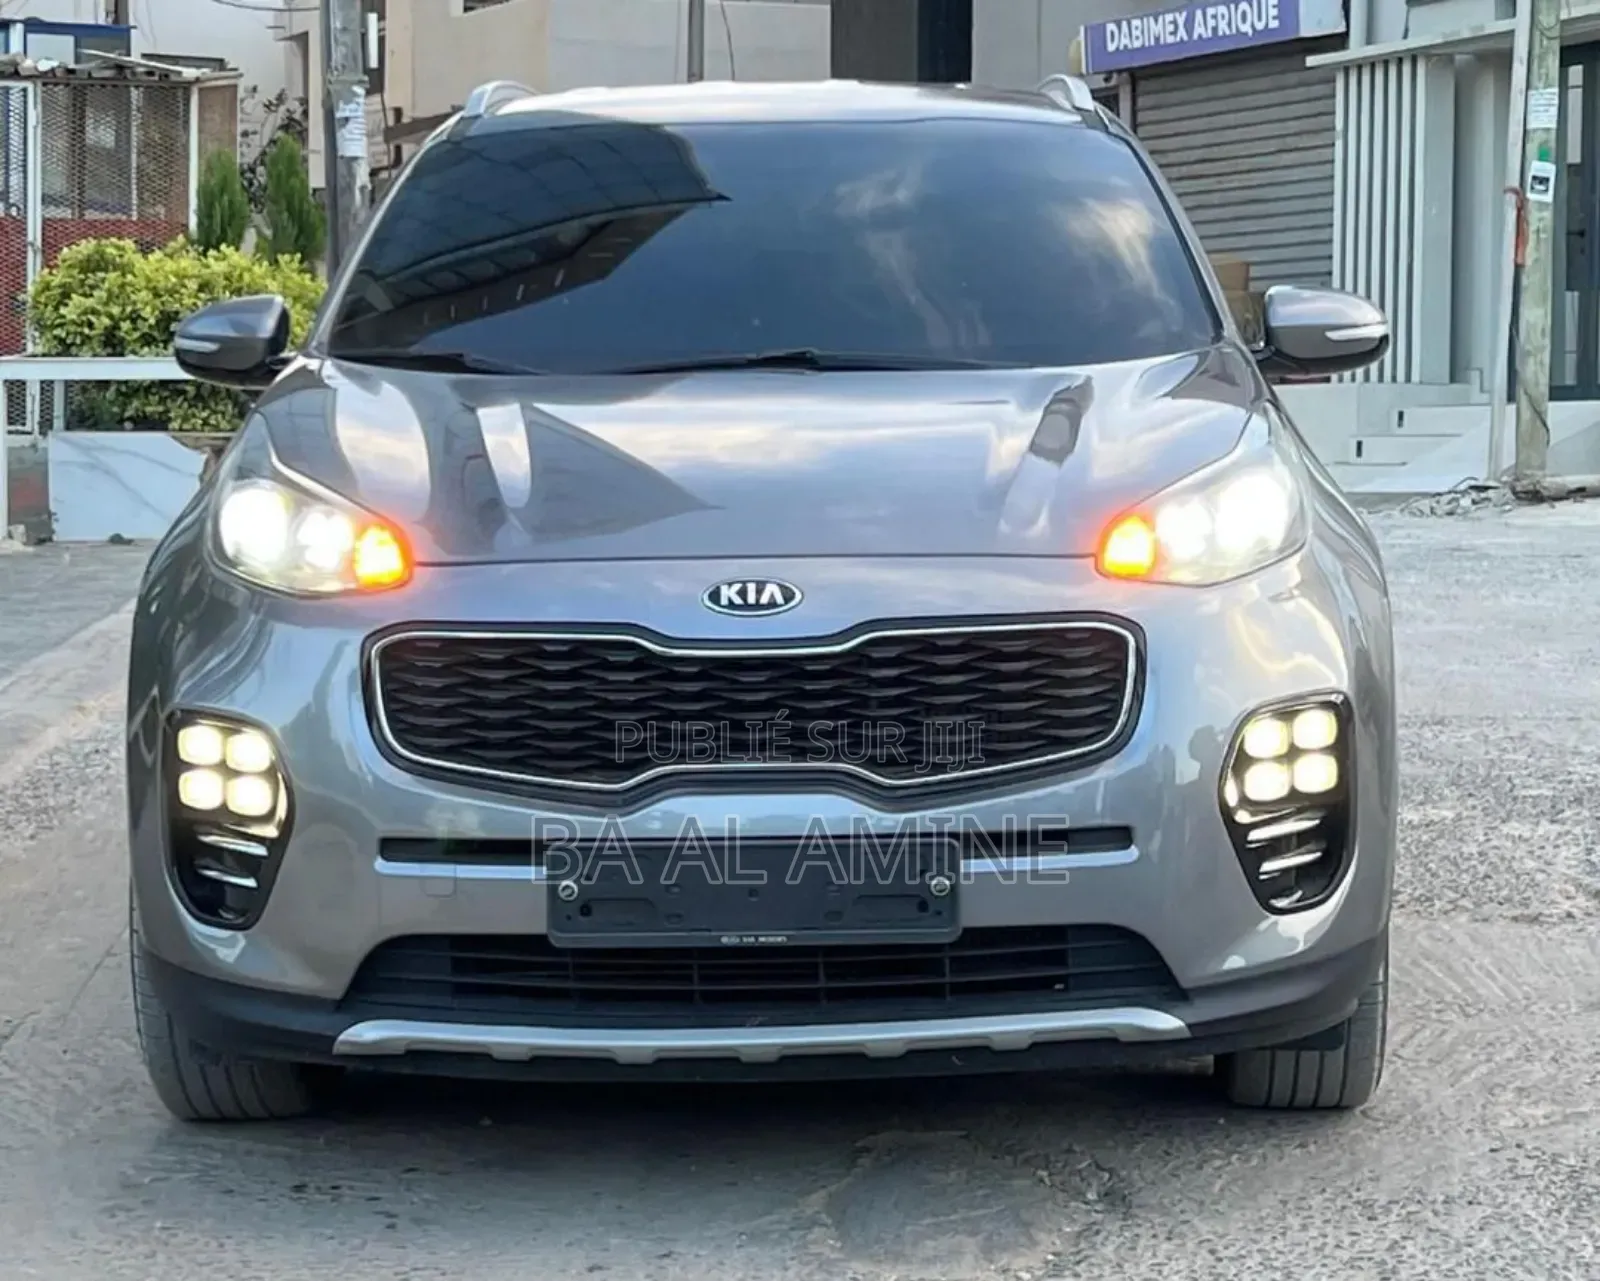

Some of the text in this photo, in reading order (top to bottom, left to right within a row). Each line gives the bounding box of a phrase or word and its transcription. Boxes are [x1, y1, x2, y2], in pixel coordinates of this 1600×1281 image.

[1106, 0, 1280, 52] DABIMEX AFRIQUE
[720, 582, 785, 606] KIA
